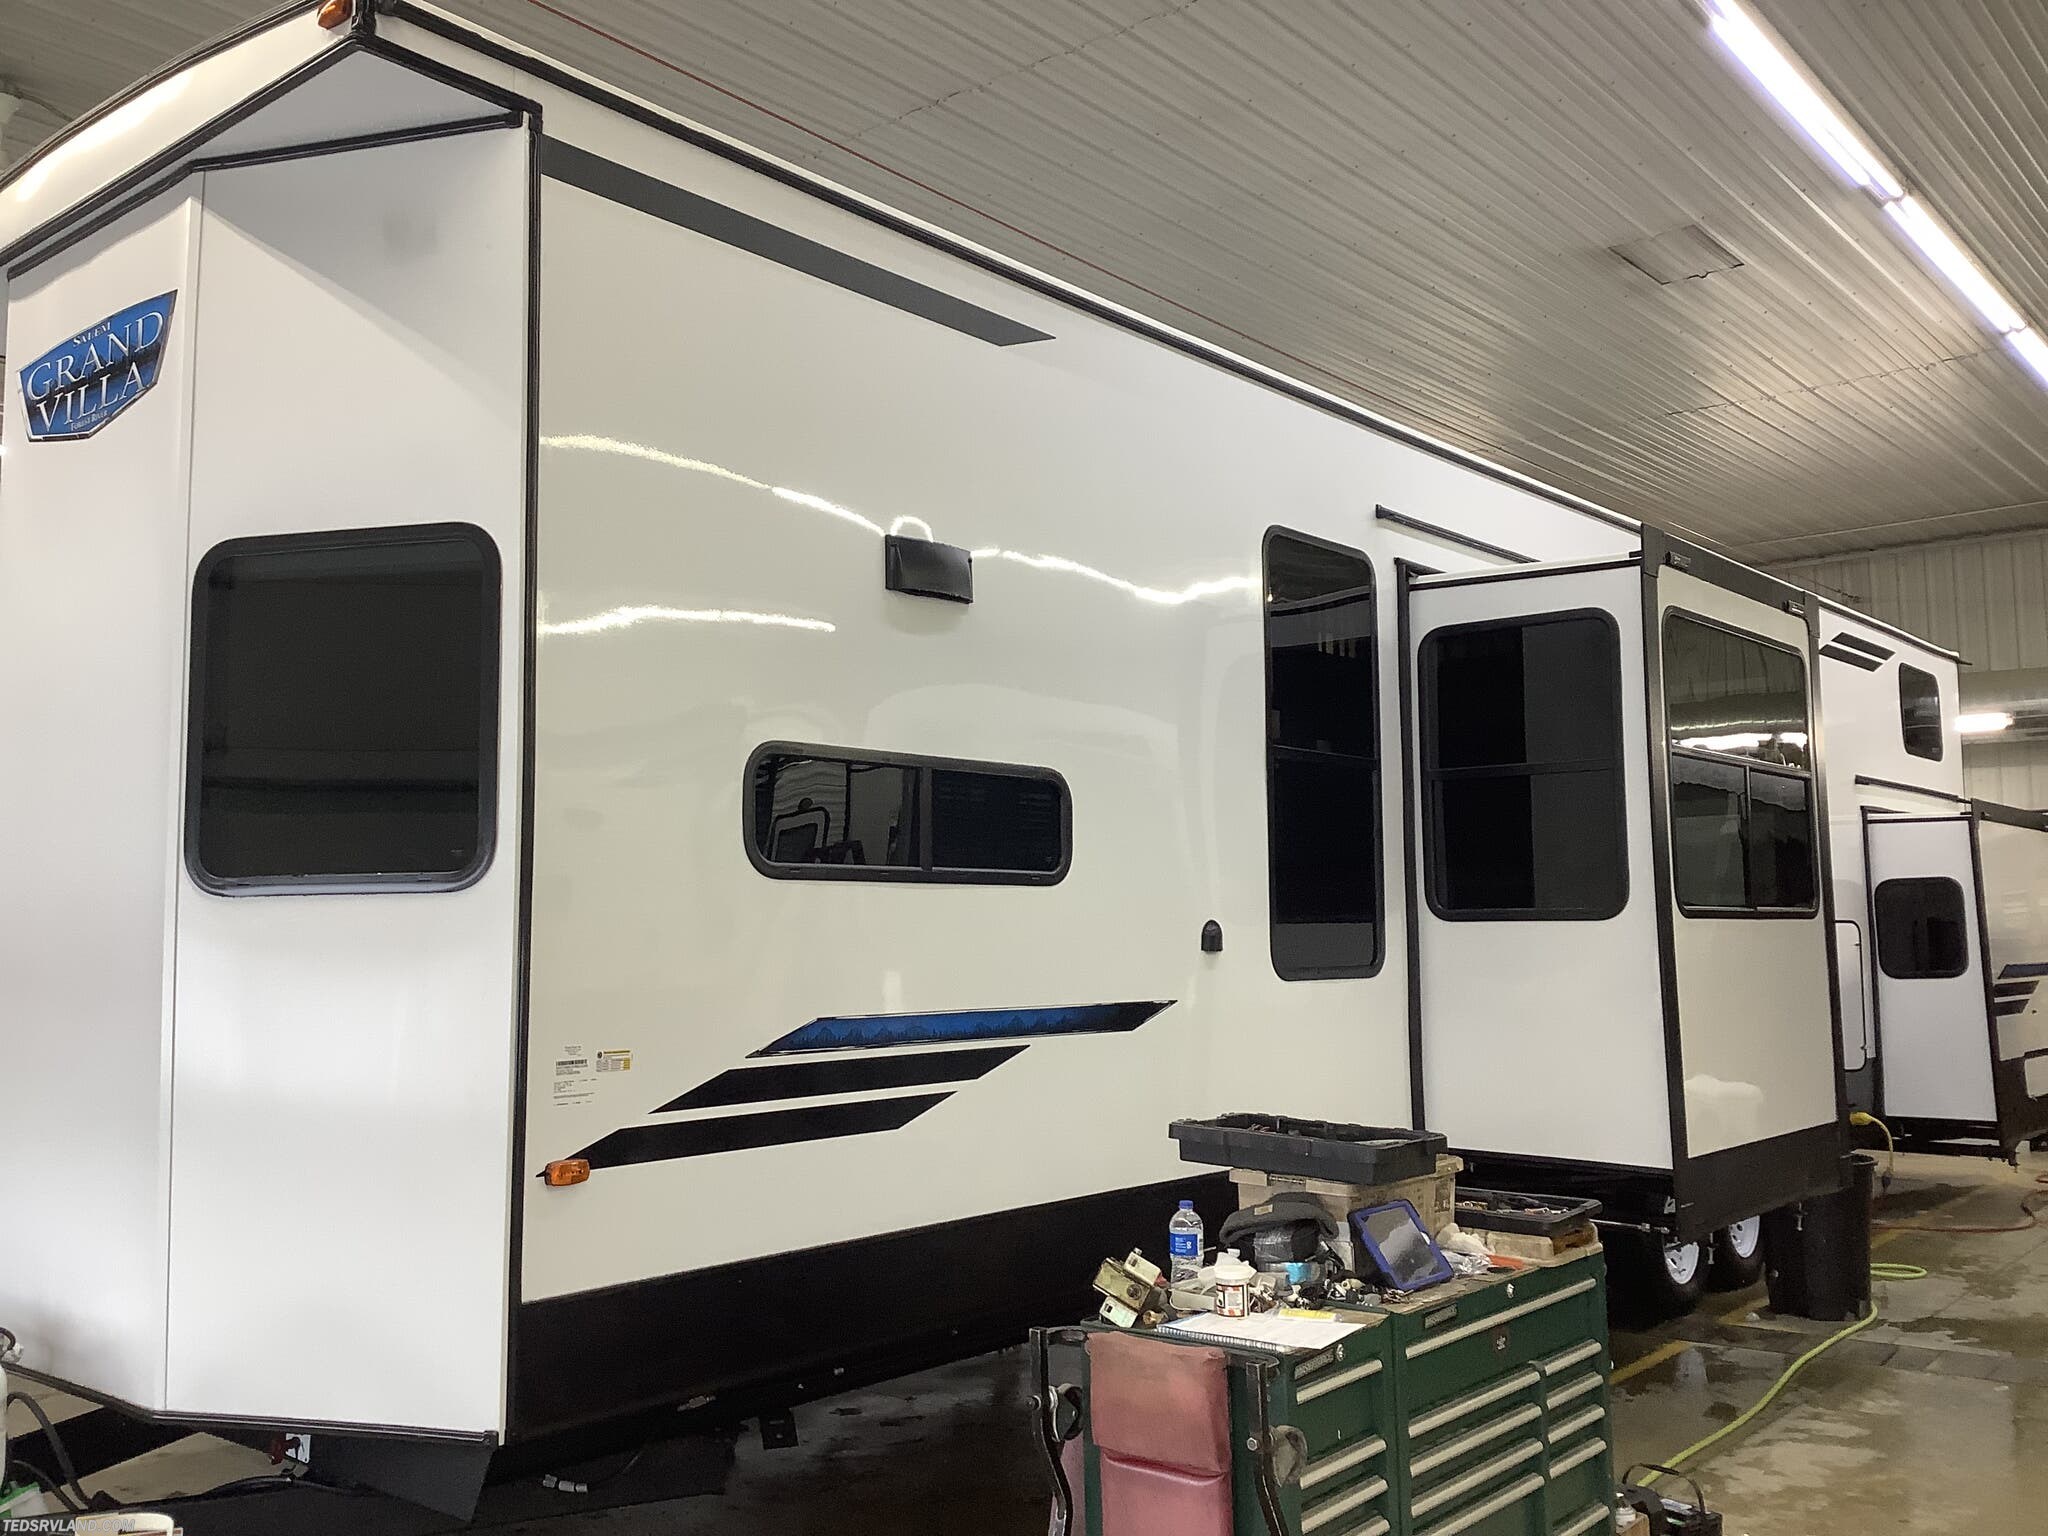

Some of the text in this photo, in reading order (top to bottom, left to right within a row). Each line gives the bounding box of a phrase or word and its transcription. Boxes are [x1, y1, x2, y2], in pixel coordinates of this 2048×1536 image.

[27, 311, 164, 401] GRAND
[73, 322, 111, 347] SALEM
[37, 361, 147, 432] VILLA
